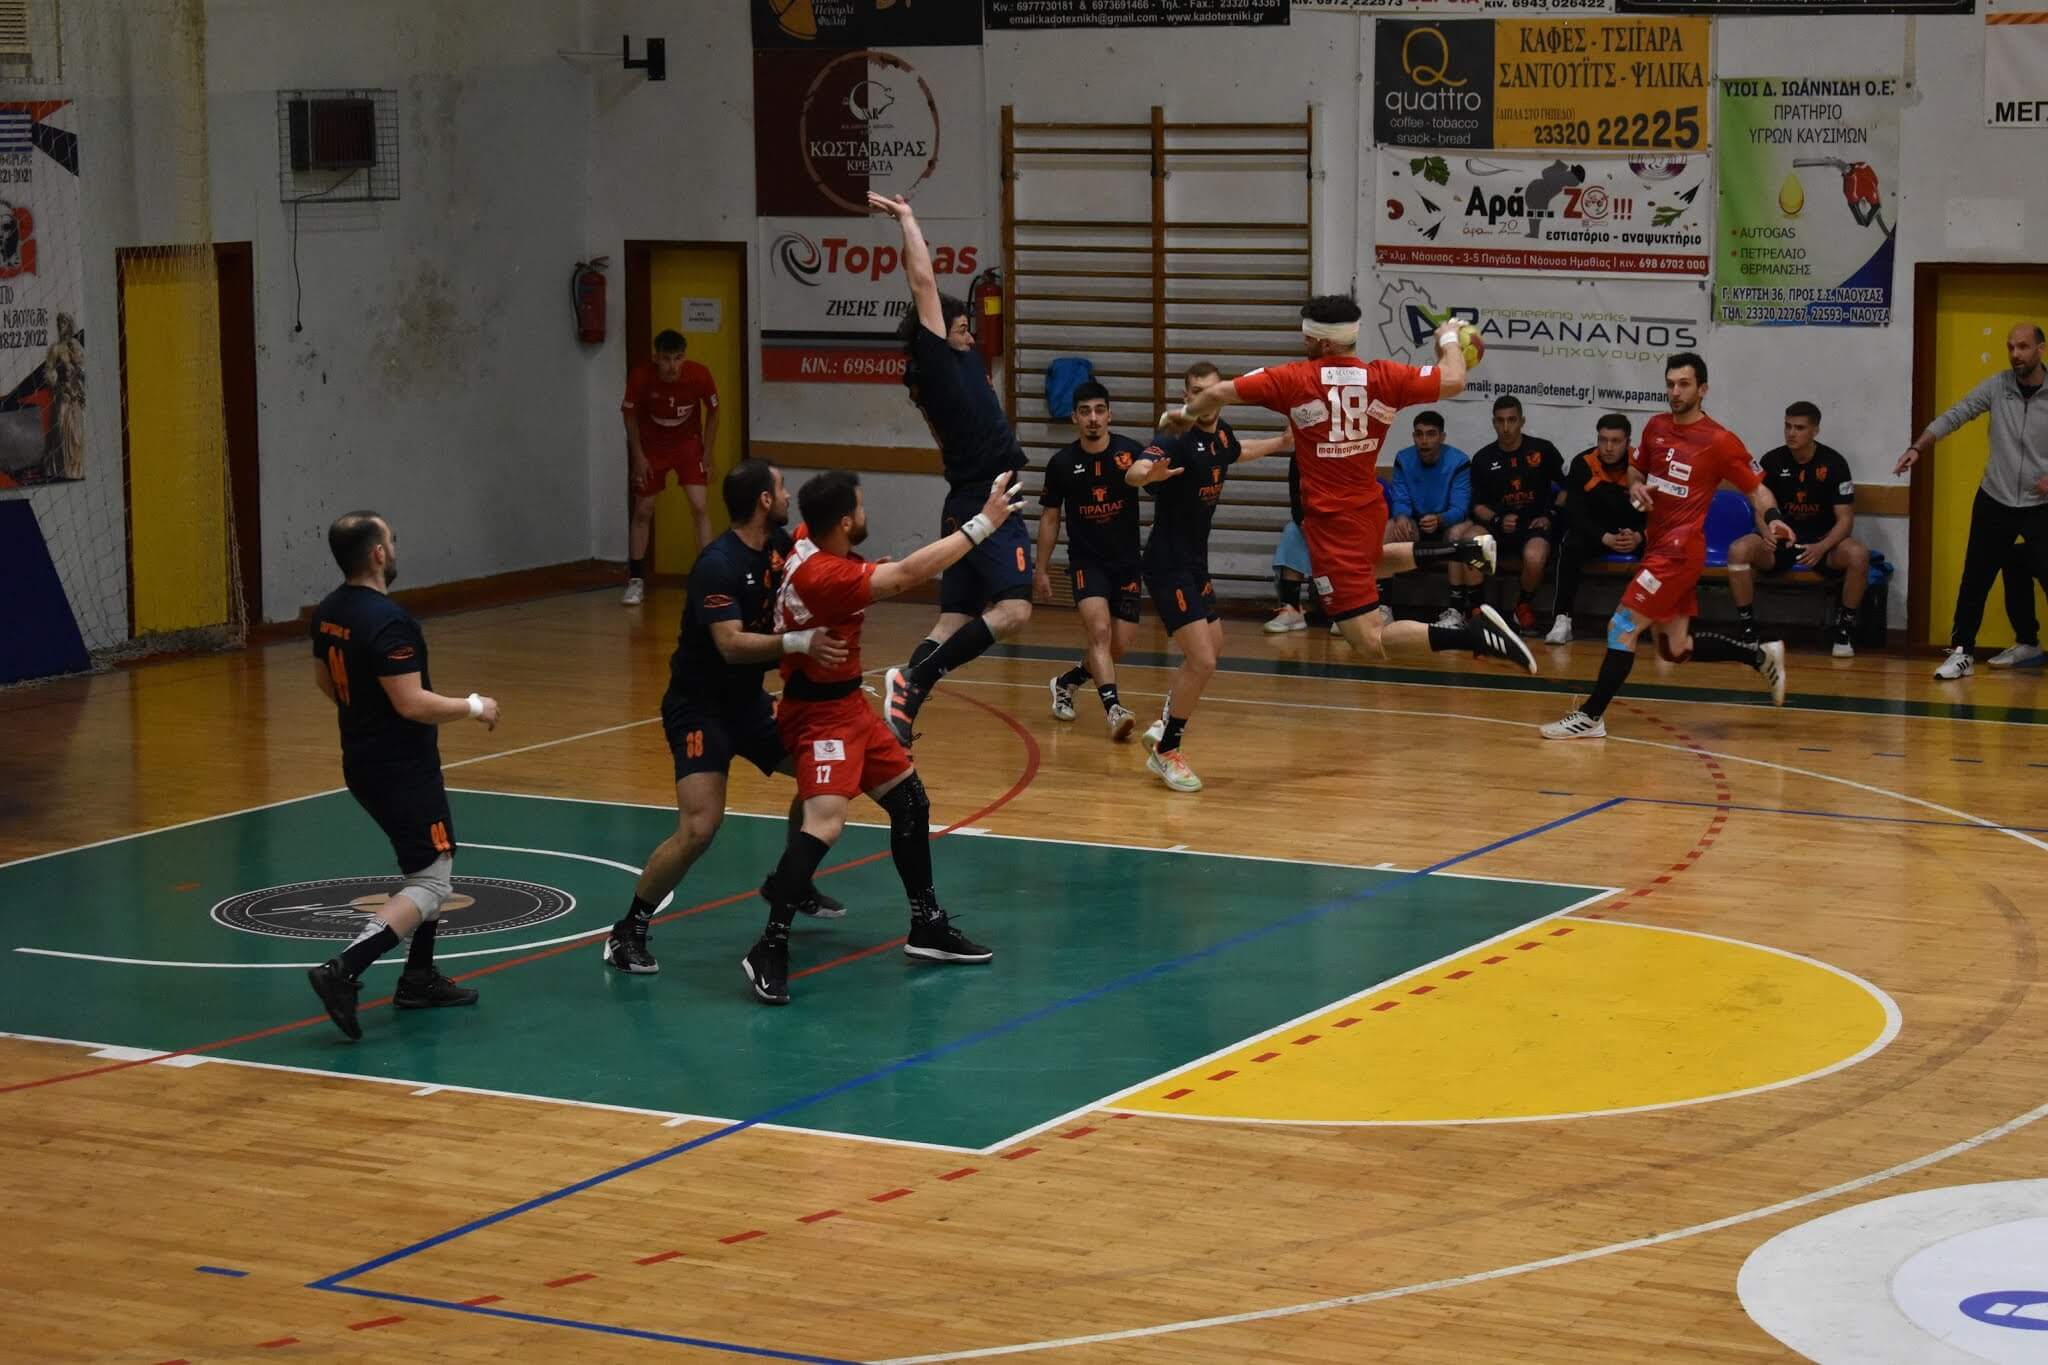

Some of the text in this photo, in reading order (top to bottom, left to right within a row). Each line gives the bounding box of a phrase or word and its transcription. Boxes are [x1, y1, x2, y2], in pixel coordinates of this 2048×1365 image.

[1520, 26, 1586, 53] ΚΑΦΕΣ
[1601, 26, 1683, 52] ΤΣΙΓΑΡΑ
[1499, 57, 1617, 88] ΣΑΝΤΟΥΪΤΣ
[1631, 62, 1705, 88] ΨΙΛΙΚΑ
[1724, 81, 1759, 97] ΥΙΟΙ
[1385, 88, 1482, 115] quattro
[1774, 104, 1842, 120] ΠΡΑΤΗΡΙΟ
[1996, 101, 2048, 122] ΜΕΓ
[1390, 116, 1424, 129] coffee
[1432, 116, 1479, 129] tobacco
[1534, 106, 1700, 149] 23320 22225
[1396, 132, 1430, 145] snack
[1438, 132, 1471, 145] bread
[1750, 128, 1867, 144] ΥΓΡΩΝ ΚΑΥΣΙΜΩΝ
[810, 141, 927, 158] ΚΩΣΤΑΒΑΡΑΣ
[847, 160, 893, 171] ΚΡΕΑΤΑ
[1546, 229, 1609, 244] εστιατόριο
[1622, 231, 1702, 247] αναψυκτήριο
[1740, 227, 1796, 239] AUTOGAS
[822, 238, 978, 281] Topas
[1411, 251, 1454, 263] Νάουσας
[1481, 253, 1521, 266] Πηγάδια
[1639, 258, 1658, 269] 698
[1740, 247, 1806, 259] ΠΕΤΡΕΛΑΙΟ
[1740, 264, 1812, 275] ΘΕΡΜΑΝΣΗΣ
[1733, 288, 1769, 300] ΚΥΡΤΣΗ
[1789, 288, 1815, 301] ΠΡΟΣ
[1837, 288, 1883, 301] ΝΑΟΥΣΑΣ
[826, 300, 879, 317] ΖΗΣΗΣ
[1746, 307, 1775, 319] 23320
[1813, 308, 1842, 320] 22593
[1851, 308, 1889, 321] ΝΑΟΥΣΑ
[843, 358, 908, 375] 698408
[1464, 380, 1492, 392] mail:
[1598, 388, 1669, 404] www.papanan
[1328, 386, 1368, 442] 18
[816, 765, 832, 784] 17
